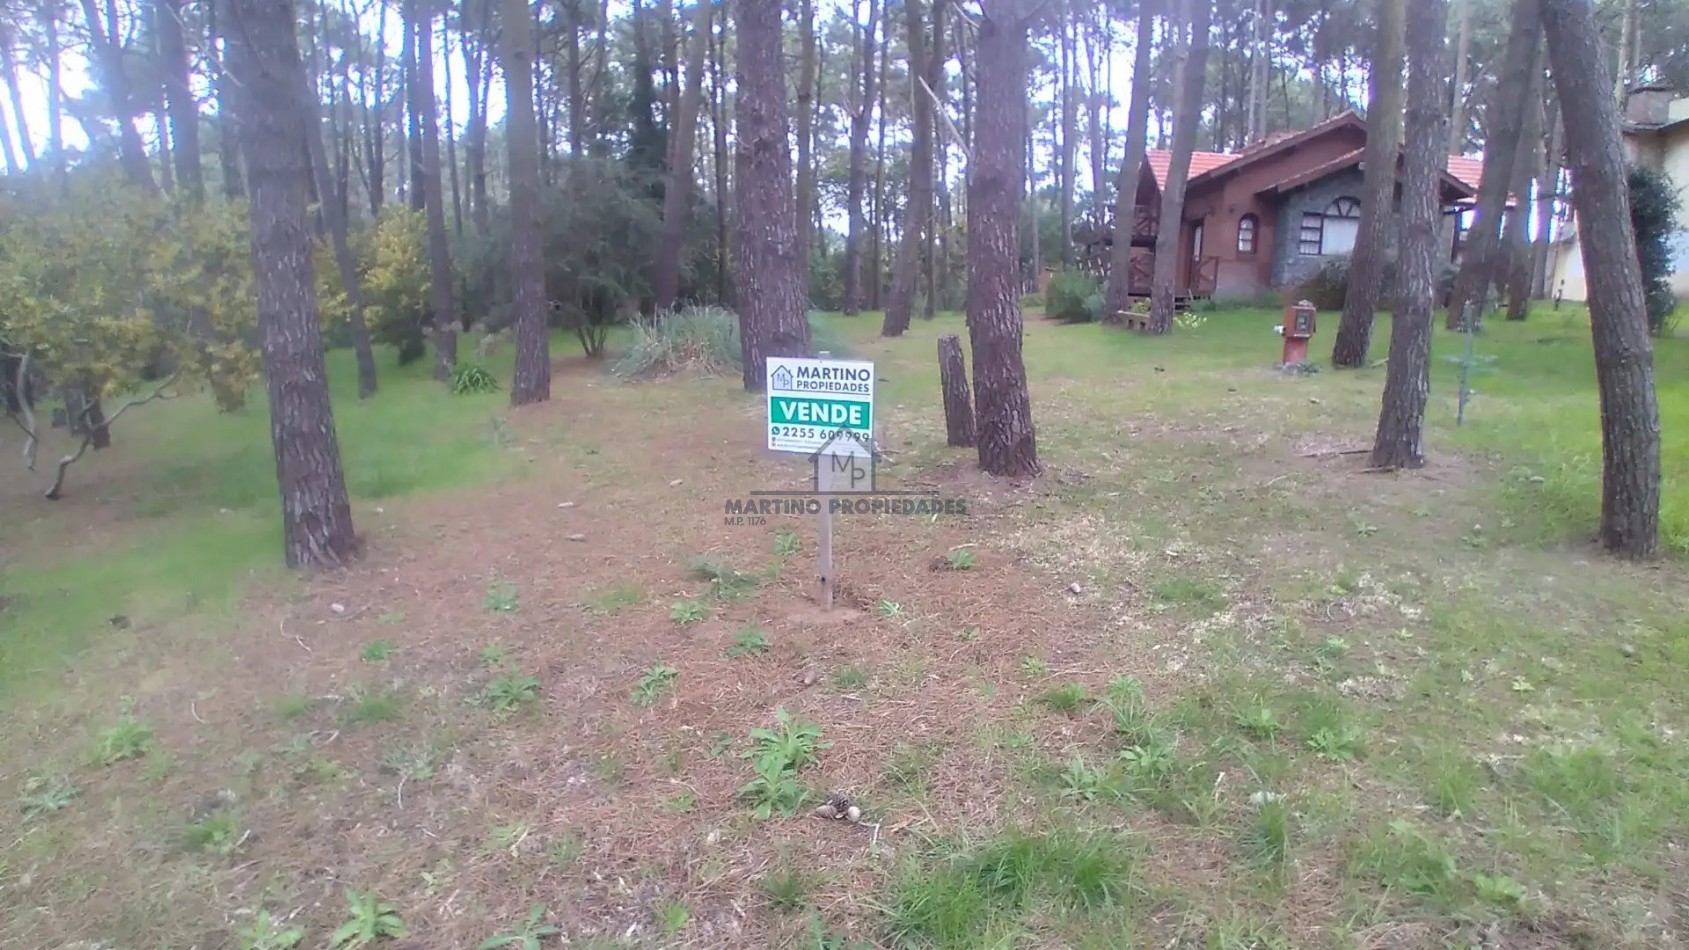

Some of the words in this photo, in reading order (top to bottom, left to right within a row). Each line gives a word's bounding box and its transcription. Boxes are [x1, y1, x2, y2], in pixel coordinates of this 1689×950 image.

[797, 366, 870, 381] MARTINO
[797, 381, 869, 392] PROPIEDADES
[779, 401, 862, 425] VENDE
[782, 426, 815, 439] 2255
[819, 429, 870, 443] 609999
